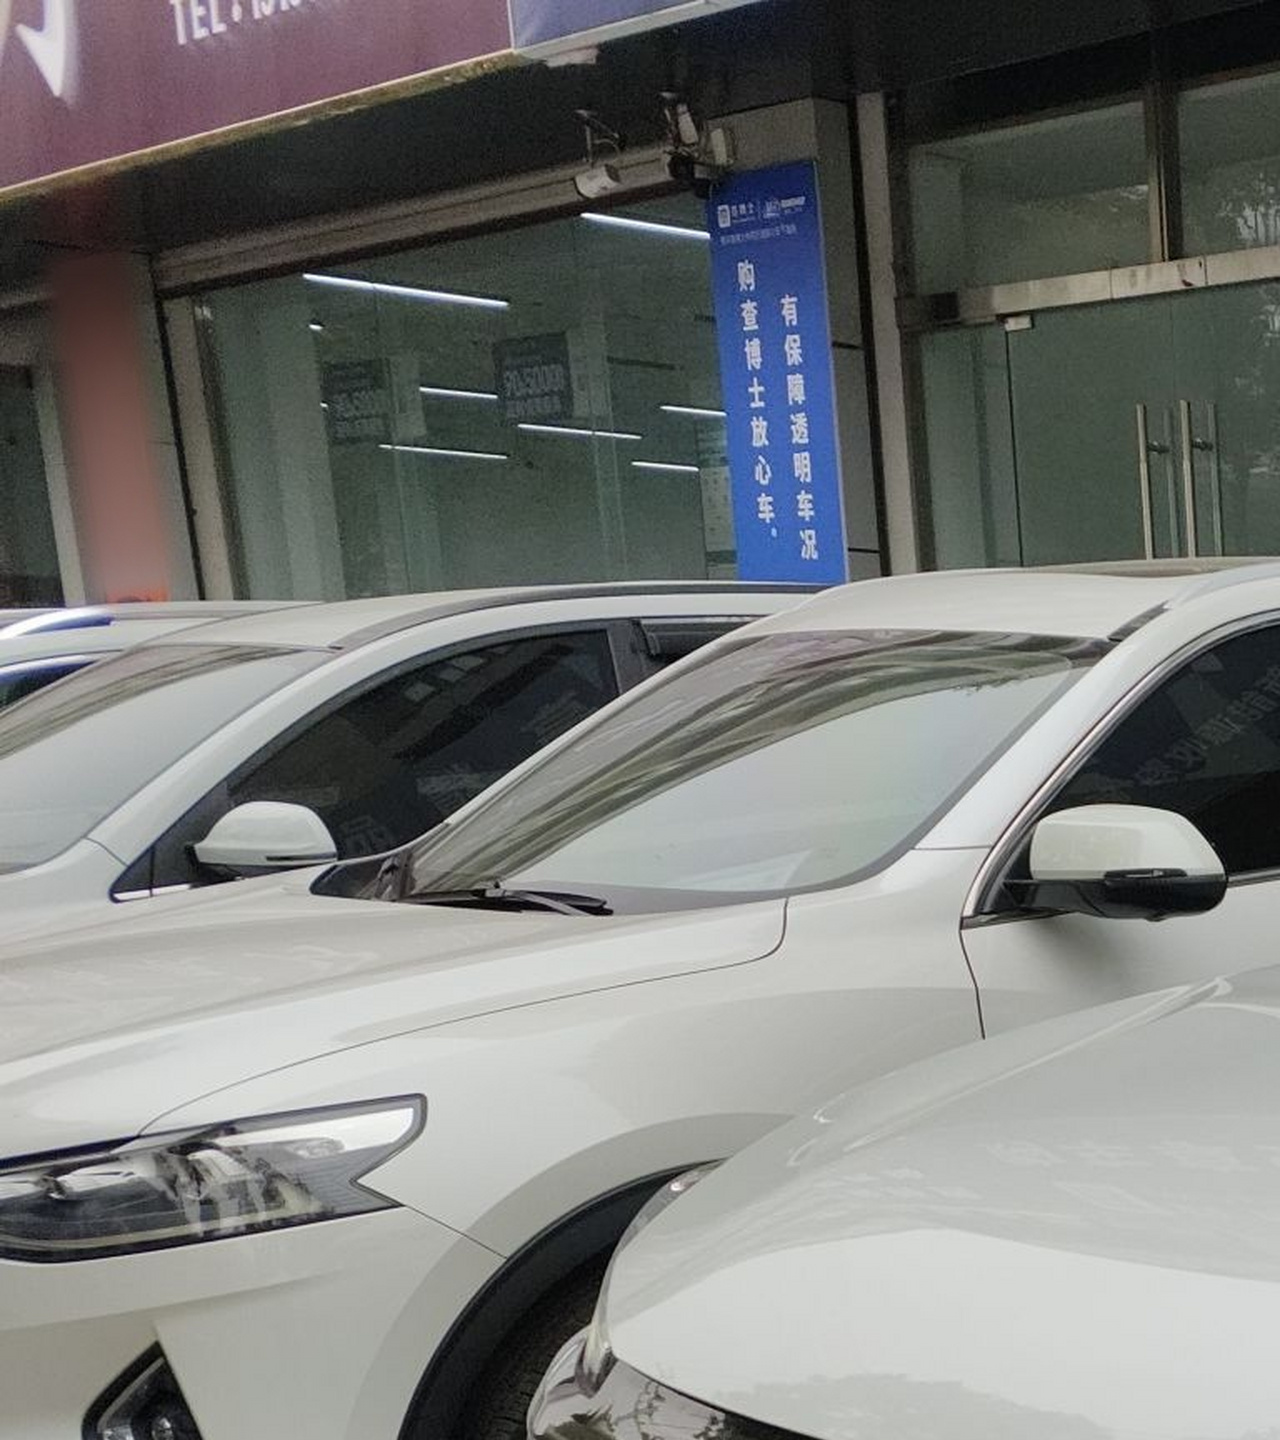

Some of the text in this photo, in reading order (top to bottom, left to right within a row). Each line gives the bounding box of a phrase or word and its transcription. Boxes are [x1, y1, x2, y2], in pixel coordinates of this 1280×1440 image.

[780, 294, 819, 560] 有保障透明车况
